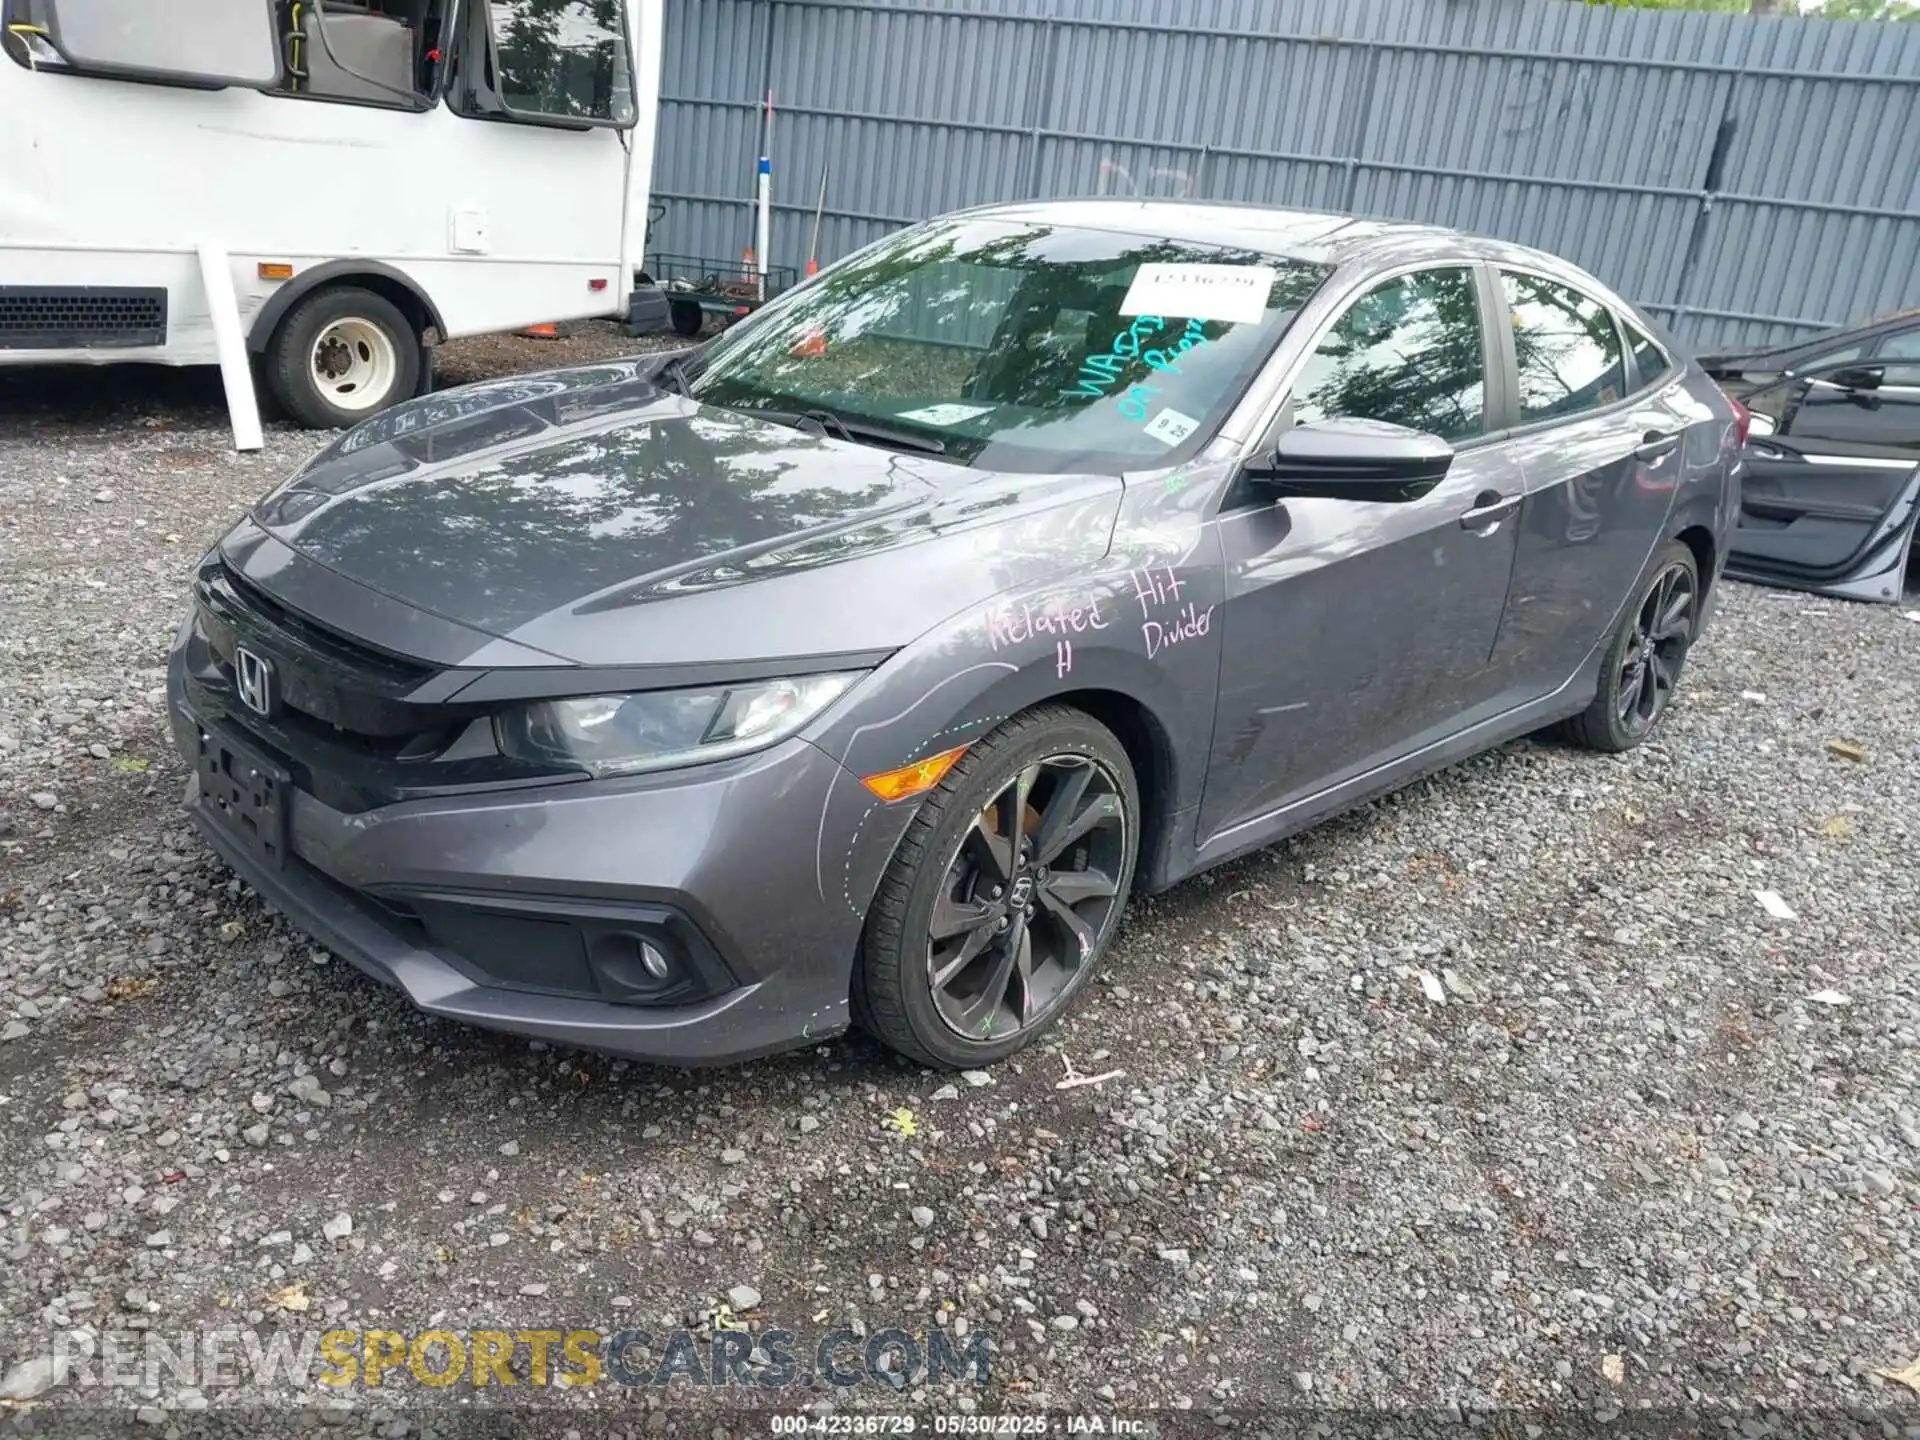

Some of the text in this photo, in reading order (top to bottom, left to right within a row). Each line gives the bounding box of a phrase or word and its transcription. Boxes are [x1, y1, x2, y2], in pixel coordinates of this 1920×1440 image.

[985, 560, 1187, 652] Related Hit
[1141, 602, 1215, 660] Divider
